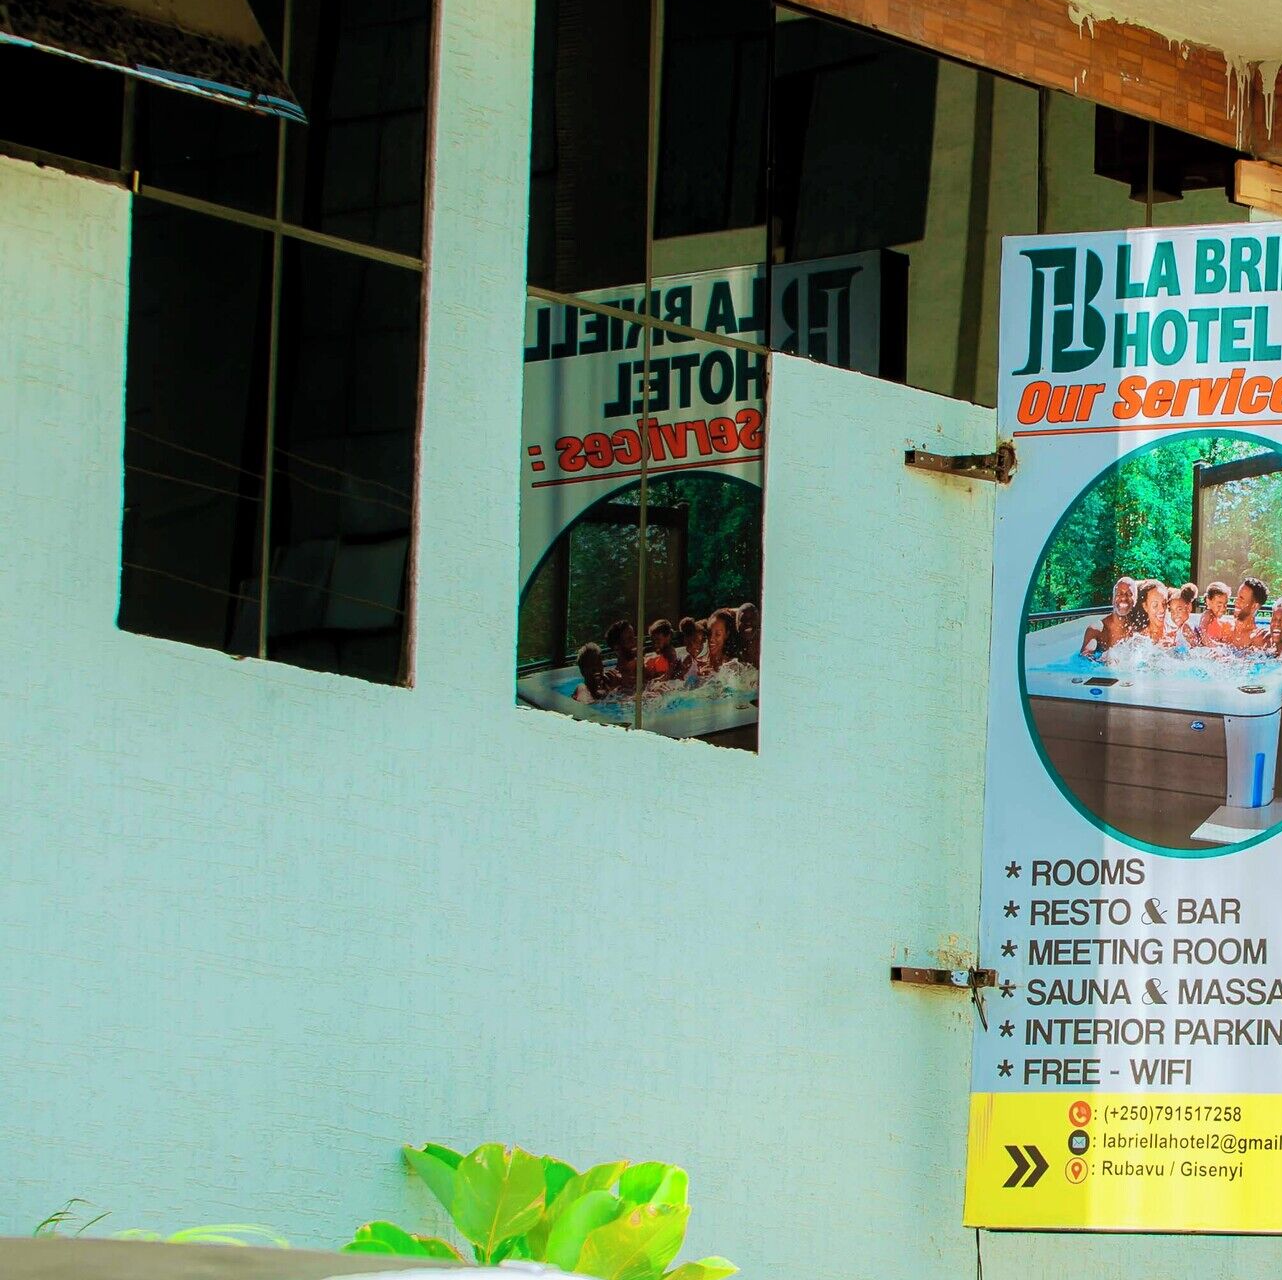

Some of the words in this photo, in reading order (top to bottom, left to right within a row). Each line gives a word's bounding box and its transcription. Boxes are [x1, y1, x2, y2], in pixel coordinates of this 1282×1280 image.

[1116, 240, 1181, 300] LA
[1113, 305, 1282, 368] HOTEL
[1017, 380, 1106, 424] Our
[1031, 858, 1146, 887] ROOMS
[1029, 898, 1131, 926] RESTO
[1140, 897, 1169, 926] &
[1177, 898, 1241, 925] BAR
[1028, 938, 1163, 966] MEETING
[1172, 938, 1267, 965] ROOM
[1026, 978, 1132, 1006] SAUNA
[1141, 977, 1169, 1006] &
[1025, 1018, 1166, 1046] INTERIOR
[1023, 1058, 1101, 1085] FREE
[1129, 1058, 1192, 1085] WIFI
[1103, 1104, 1242, 1125] (+250)791517258
[1101, 1160, 1165, 1177] Rubavu
[1180, 1160, 1243, 1182] Gisenyi
